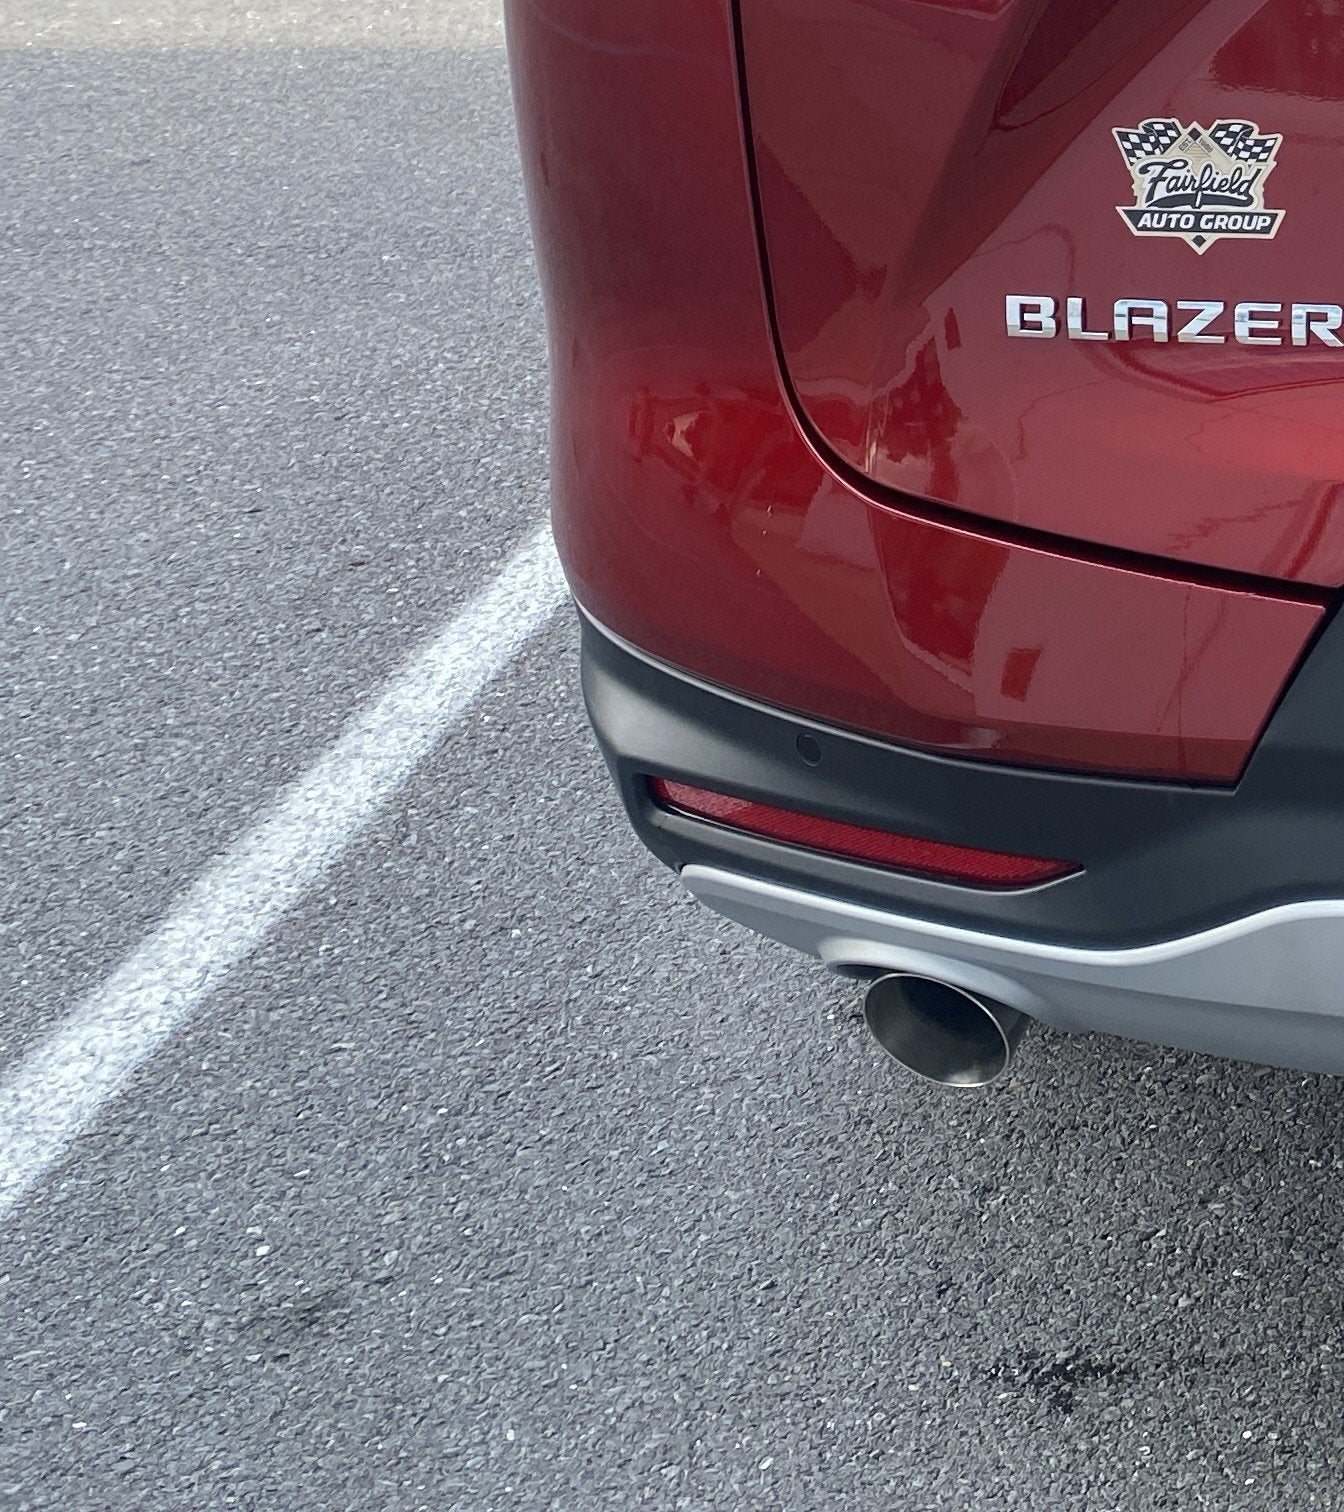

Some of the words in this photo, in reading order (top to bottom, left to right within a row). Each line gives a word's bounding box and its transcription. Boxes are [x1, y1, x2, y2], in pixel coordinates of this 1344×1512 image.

[1138, 158, 1263, 204] Fairfield
[1137, 212, 1195, 229] AUTO
[1199, 213, 1272, 231] GROUP
[1005, 294, 1344, 347] BLAZER
